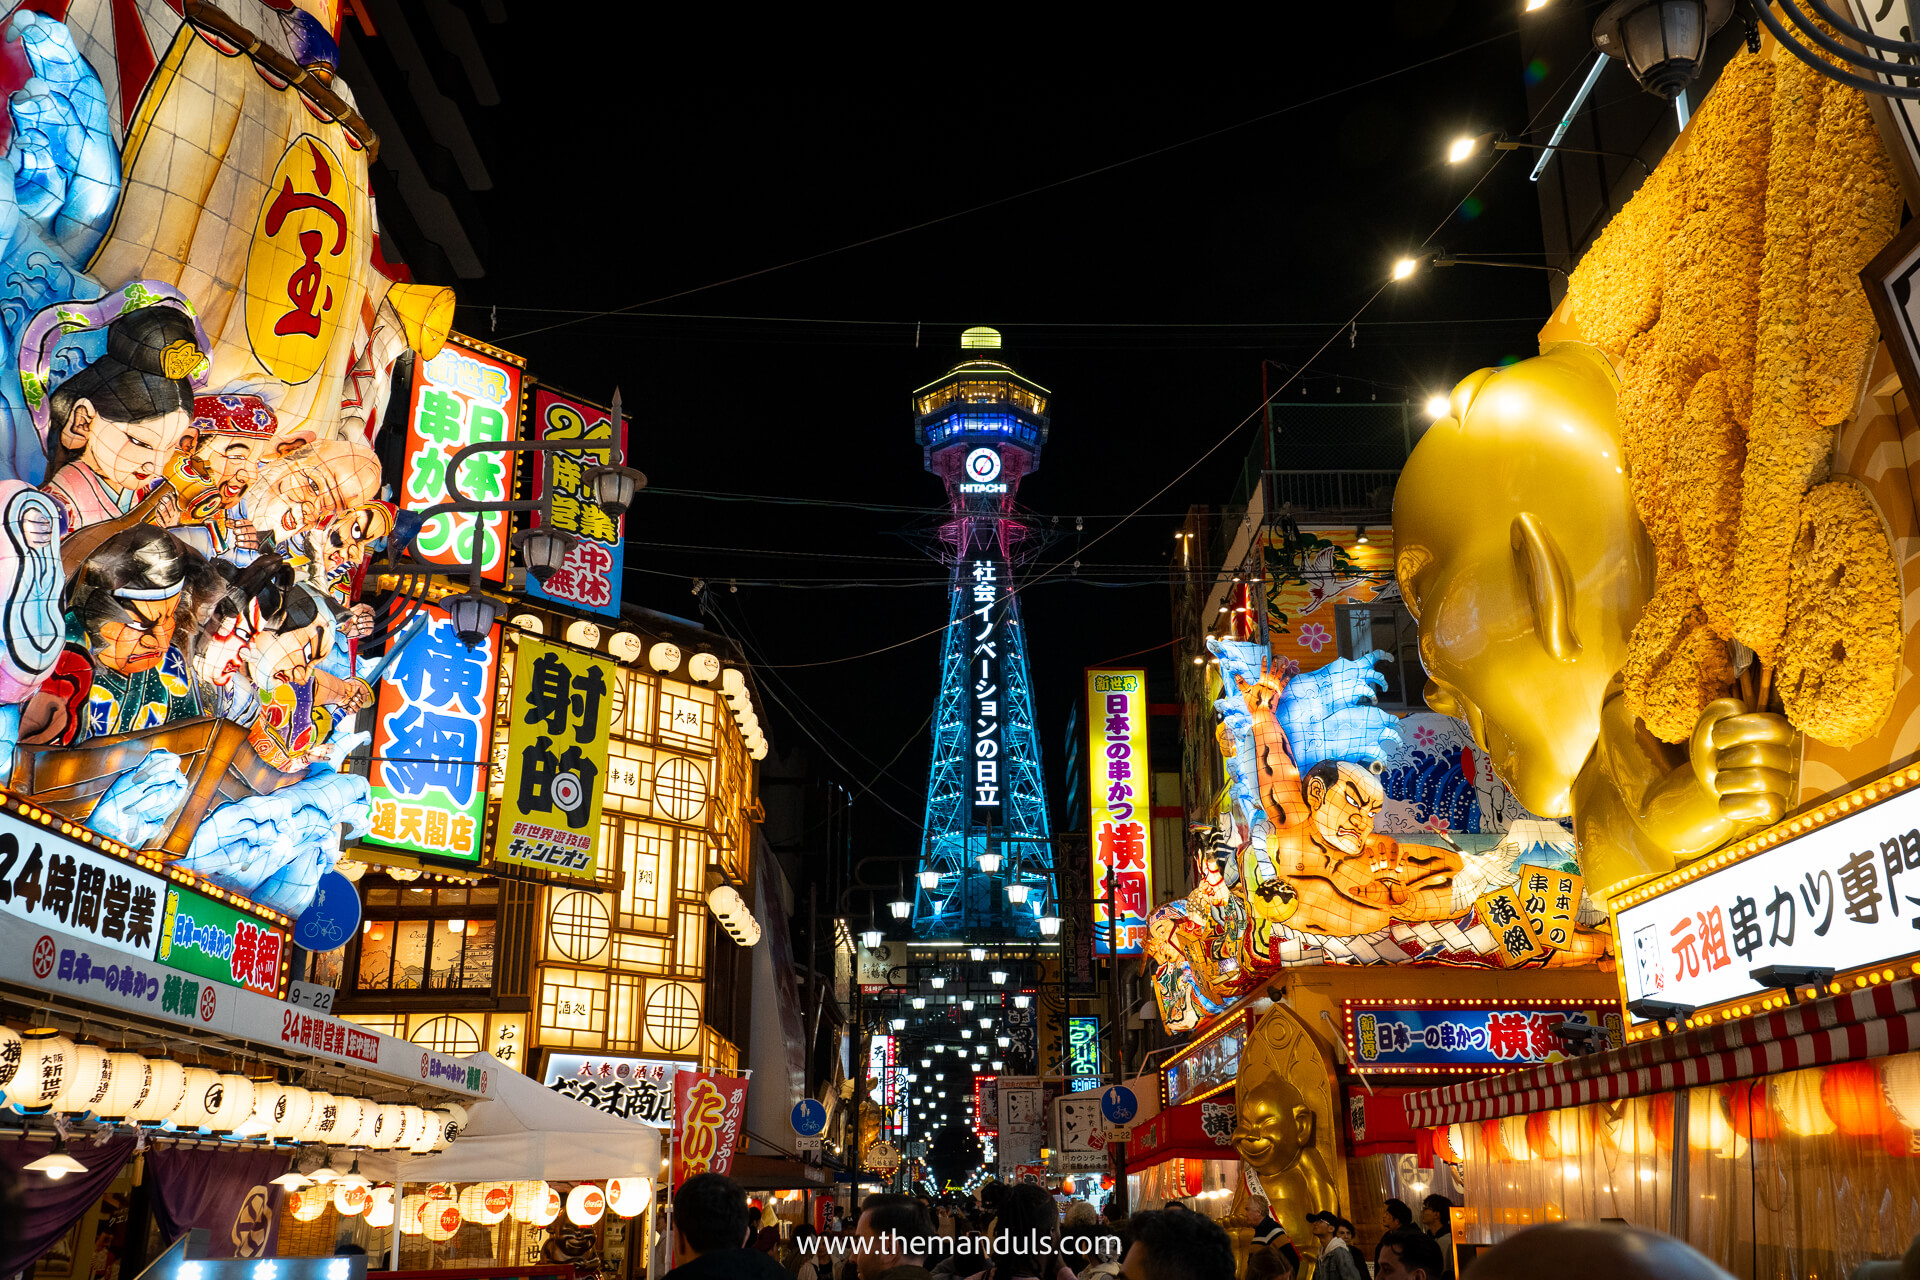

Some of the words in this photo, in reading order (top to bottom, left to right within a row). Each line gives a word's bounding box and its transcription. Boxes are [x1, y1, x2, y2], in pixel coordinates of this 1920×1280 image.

[426, 351, 508, 405] 新世界
[960, 484, 1007, 494] HITACHI
[972, 560, 1001, 807] 社会イノベーションの日立
[1095, 674, 1138, 692] 新世界
[384, 614, 489, 806] 横綱
[674, 708, 699, 727] 大阪
[516, 652, 608, 830] 射的
[1105, 693, 1134, 821] 日本一の串かつ
[370, 800, 475, 853] 通天閣店
[508, 839, 591, 871] チャンピオン
[0, 832, 157, 950] 24時間営業
[231, 920, 282, 991] 横綱
[57, 948, 160, 1002] 日本一の串かつ
[161, 973, 201, 1019] 横綱
[281, 1008, 347, 1056] 24時間営業
[1359, 1015, 1377, 1060] 新世界
[1378, 1022, 1486, 1051] 日本一の串かつ
[39, 1064, 64, 1102] 新世界
[41, 1053, 64, 1065] 大阪
[715, 1088, 744, 1174] あんたっぷり
[823, 1201, 834, 1232] おでん
